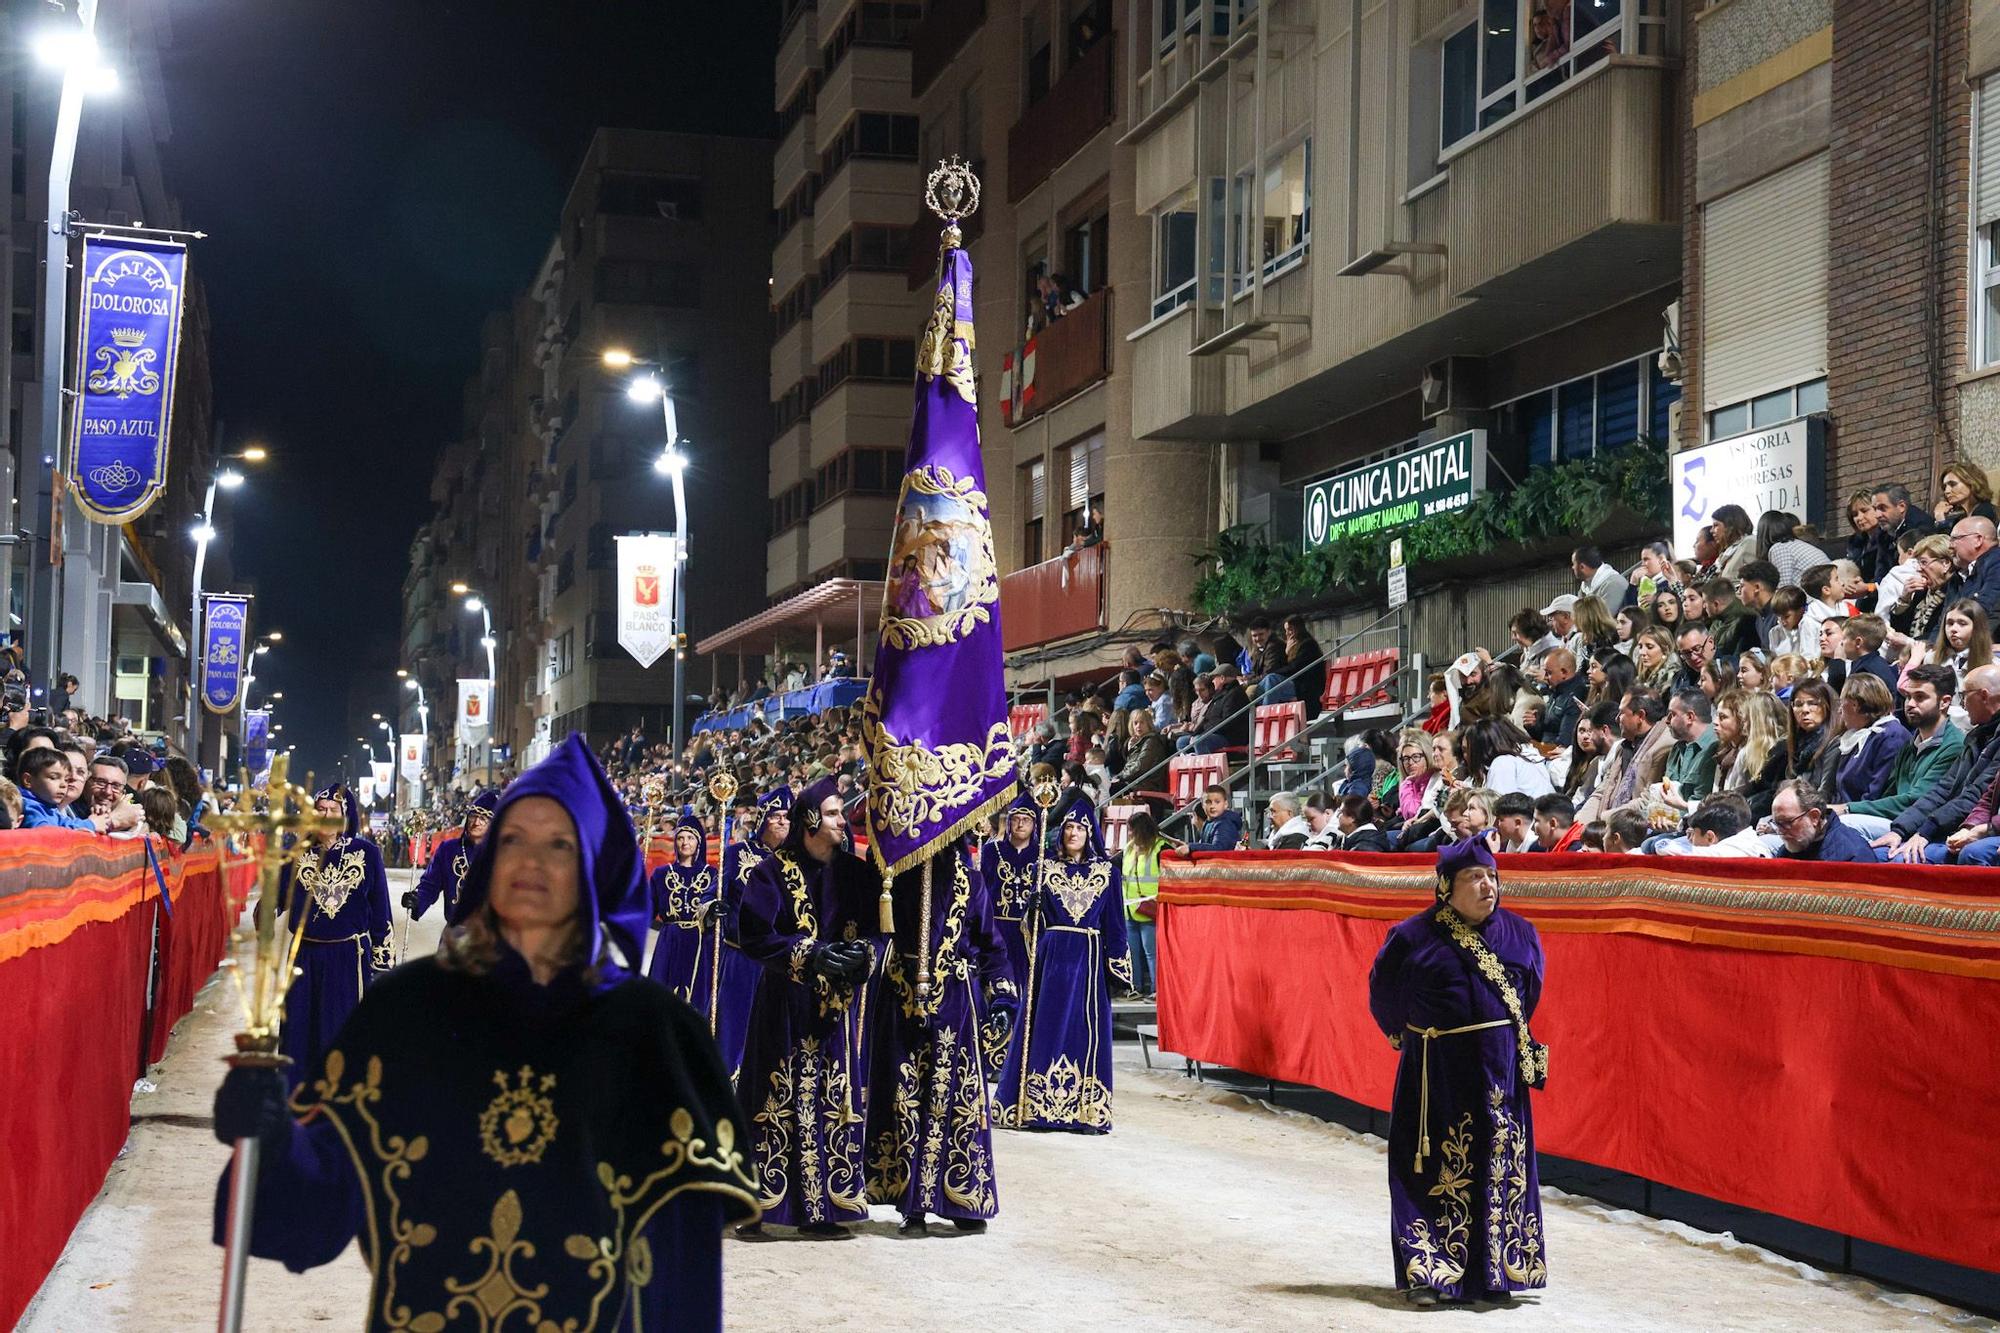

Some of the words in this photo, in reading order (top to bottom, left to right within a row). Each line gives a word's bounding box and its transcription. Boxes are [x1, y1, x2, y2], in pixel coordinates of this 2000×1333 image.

[101, 261, 165, 291] MATER
[92, 293, 169, 316] DOLOROSA
[84, 419, 117, 436] PASO
[118, 420, 157, 438] AZUL
[1329, 466, 1393, 518] CLINICA
[1397, 441, 1469, 498] DENTAL
[1381, 500, 1419, 528] MANZANO
[625, 621, 666, 632] BLANCO
[632, 611, 660, 621] PASO
